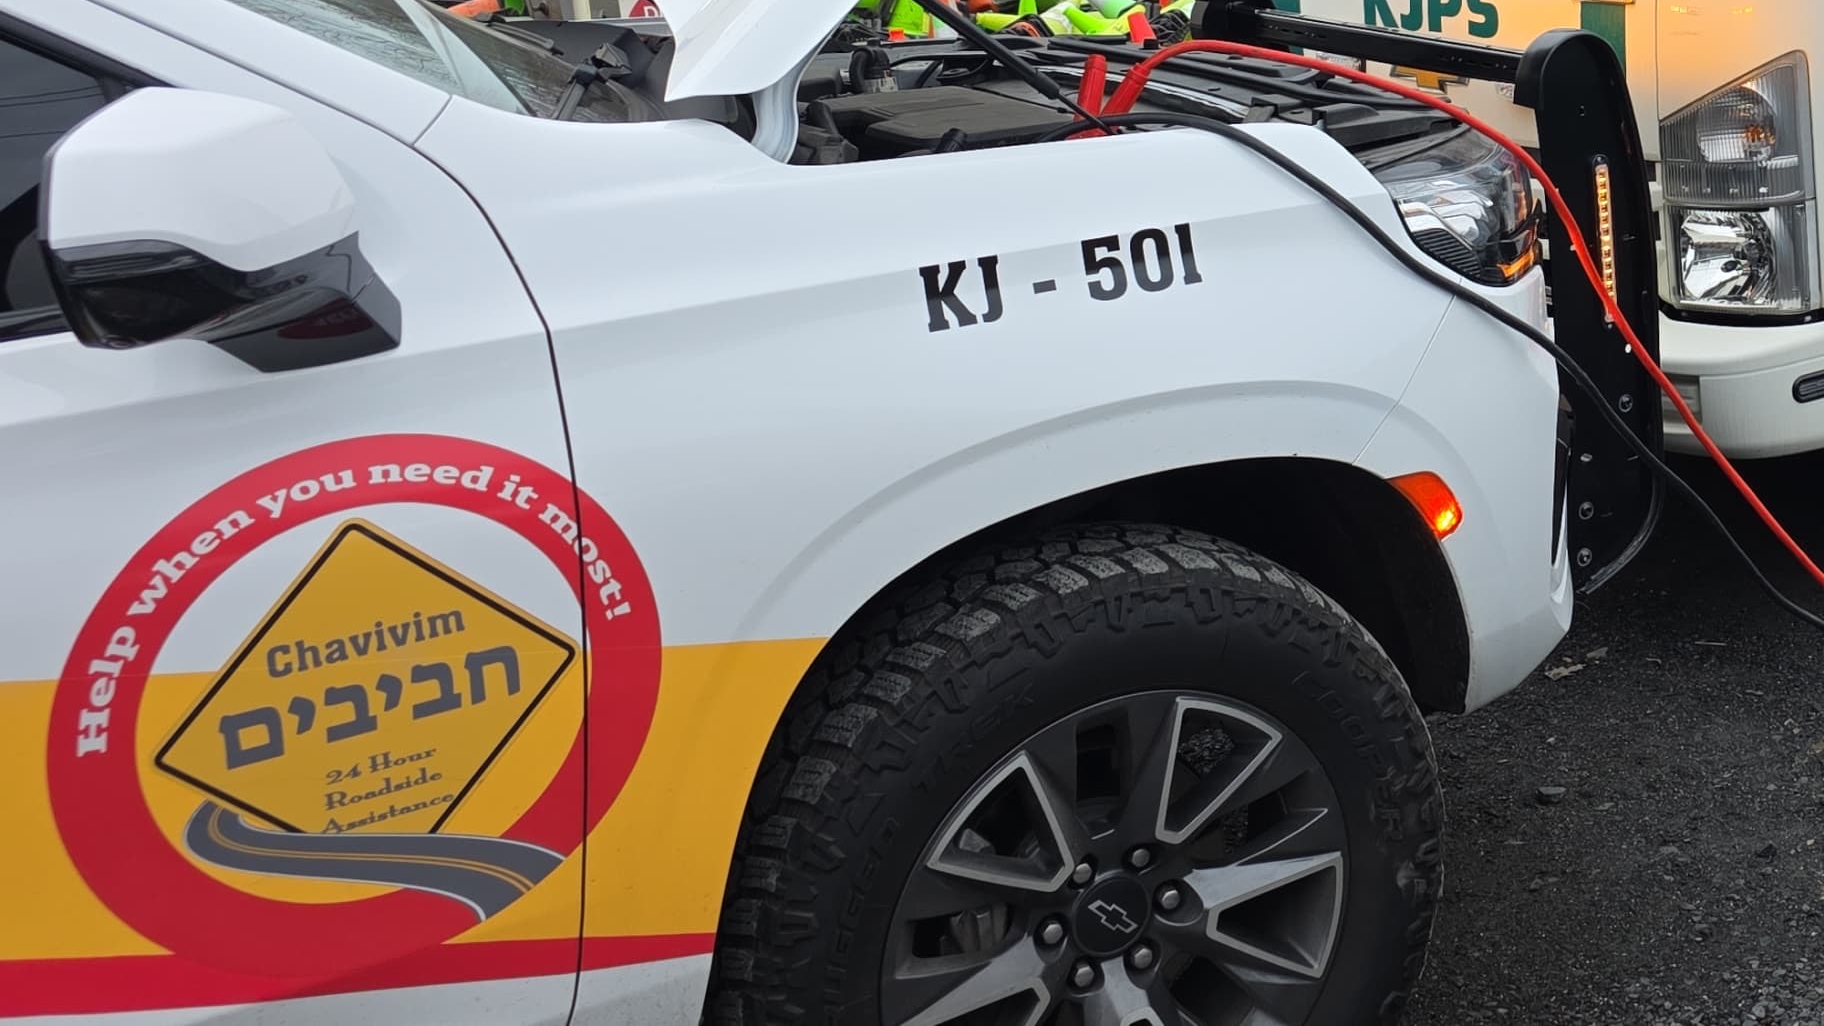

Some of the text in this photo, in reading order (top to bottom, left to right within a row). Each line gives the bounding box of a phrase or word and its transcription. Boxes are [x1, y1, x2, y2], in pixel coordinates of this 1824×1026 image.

[919, 222, 1203, 333] KJ - 501
[76, 461, 632, 759] Help when you need it most!
[266, 608, 467, 679] Chavivim
[218, 645, 521, 772] חביבים
[323, 769, 444, 811] Roadside
[325, 747, 438, 786] 24 Hour
[321, 791, 456, 835] Assistance
